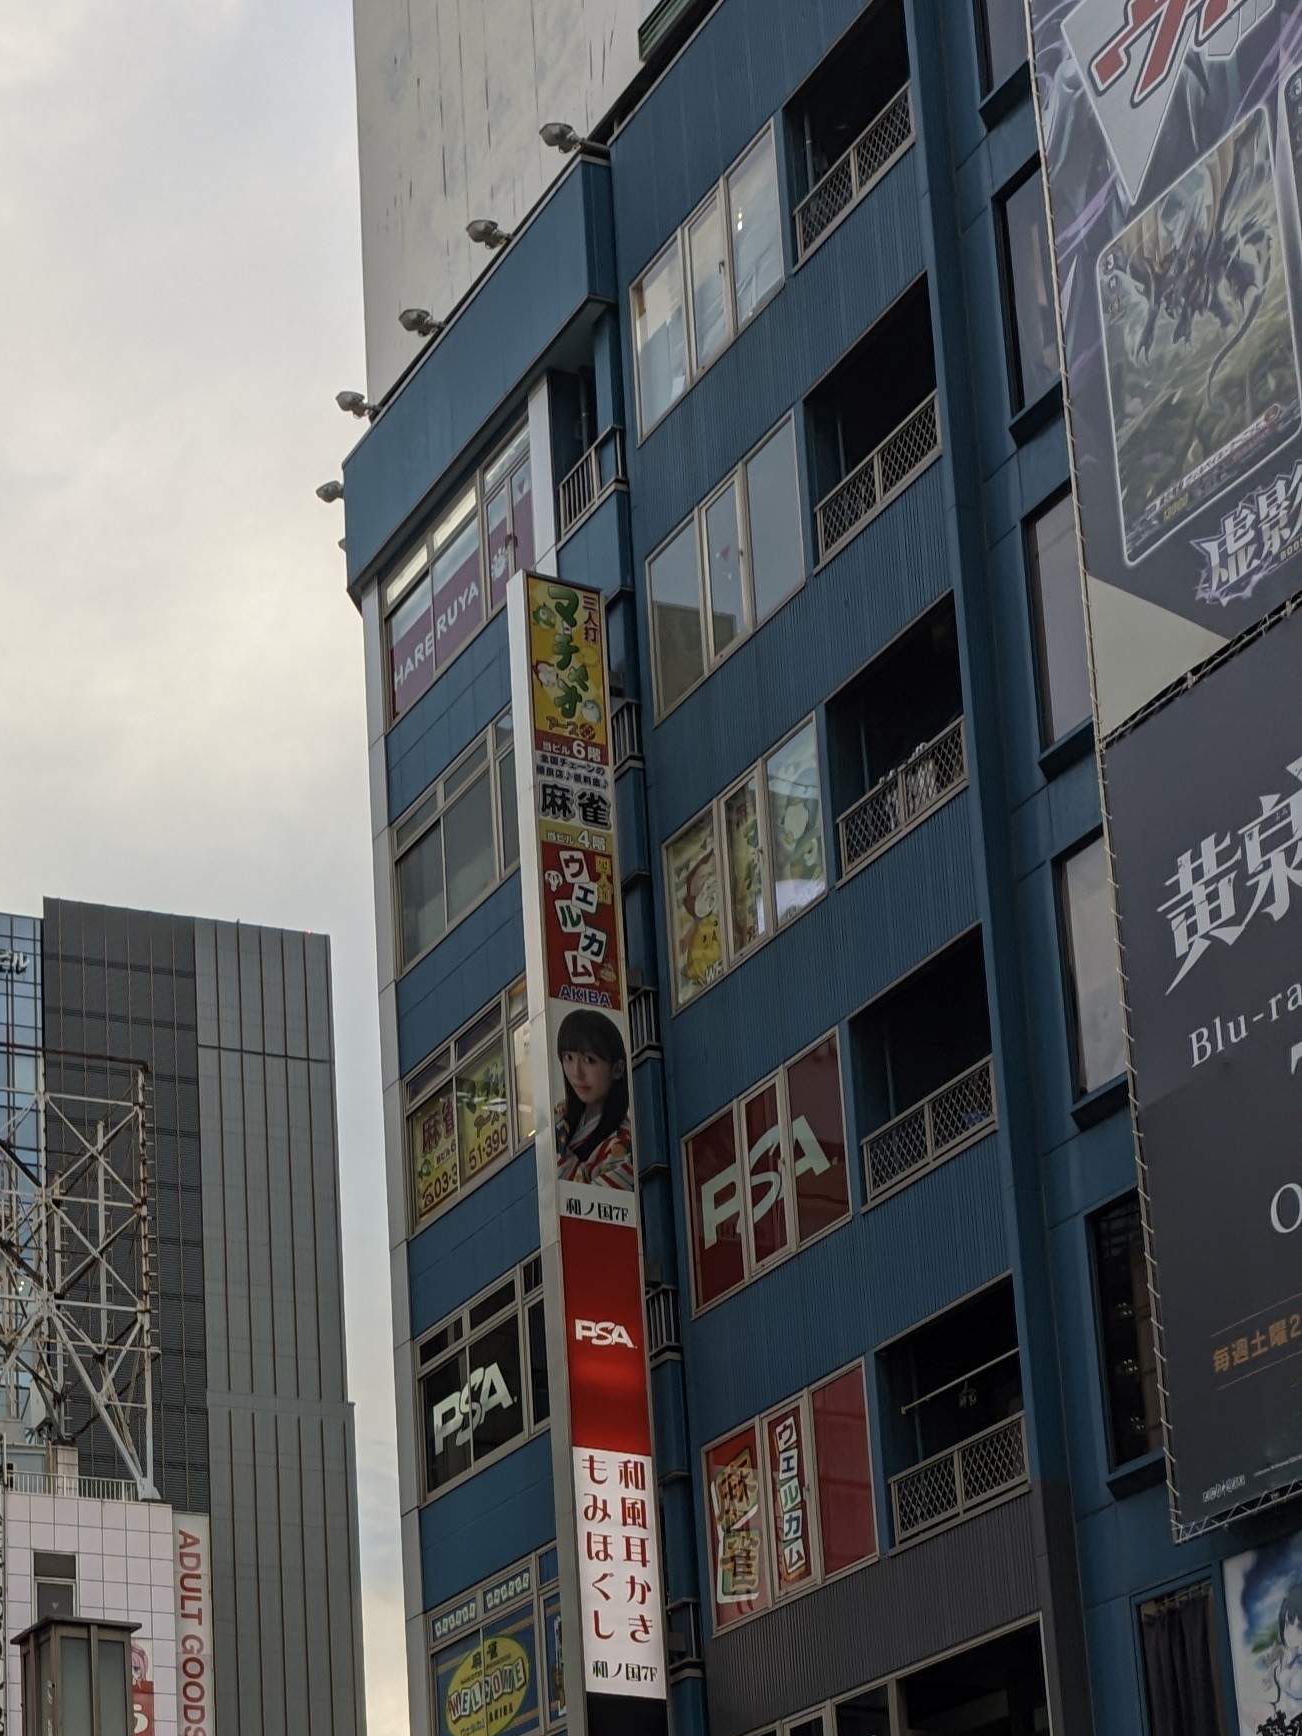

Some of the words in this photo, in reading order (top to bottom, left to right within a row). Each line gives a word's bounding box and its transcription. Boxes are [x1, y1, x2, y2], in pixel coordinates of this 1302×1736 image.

[393, 581, 480, 692] HARERUYA
[540, 781, 612, 827] 麻雀
[559, 984, 611, 1007] AKIBA
[700, 1113, 829, 1250] PSA
[575, 1318, 636, 1349] PSA
[433, 1362, 517, 1456] PSA
[179, 1528, 203, 1625] ADULT
[581, 1454, 615, 1642] もみほぐし
[618, 1457, 655, 1645] 和風耳かき
[448, 1657, 527, 1723] WELCOME
[592, 1659, 658, 1683] 和ノ国7F
